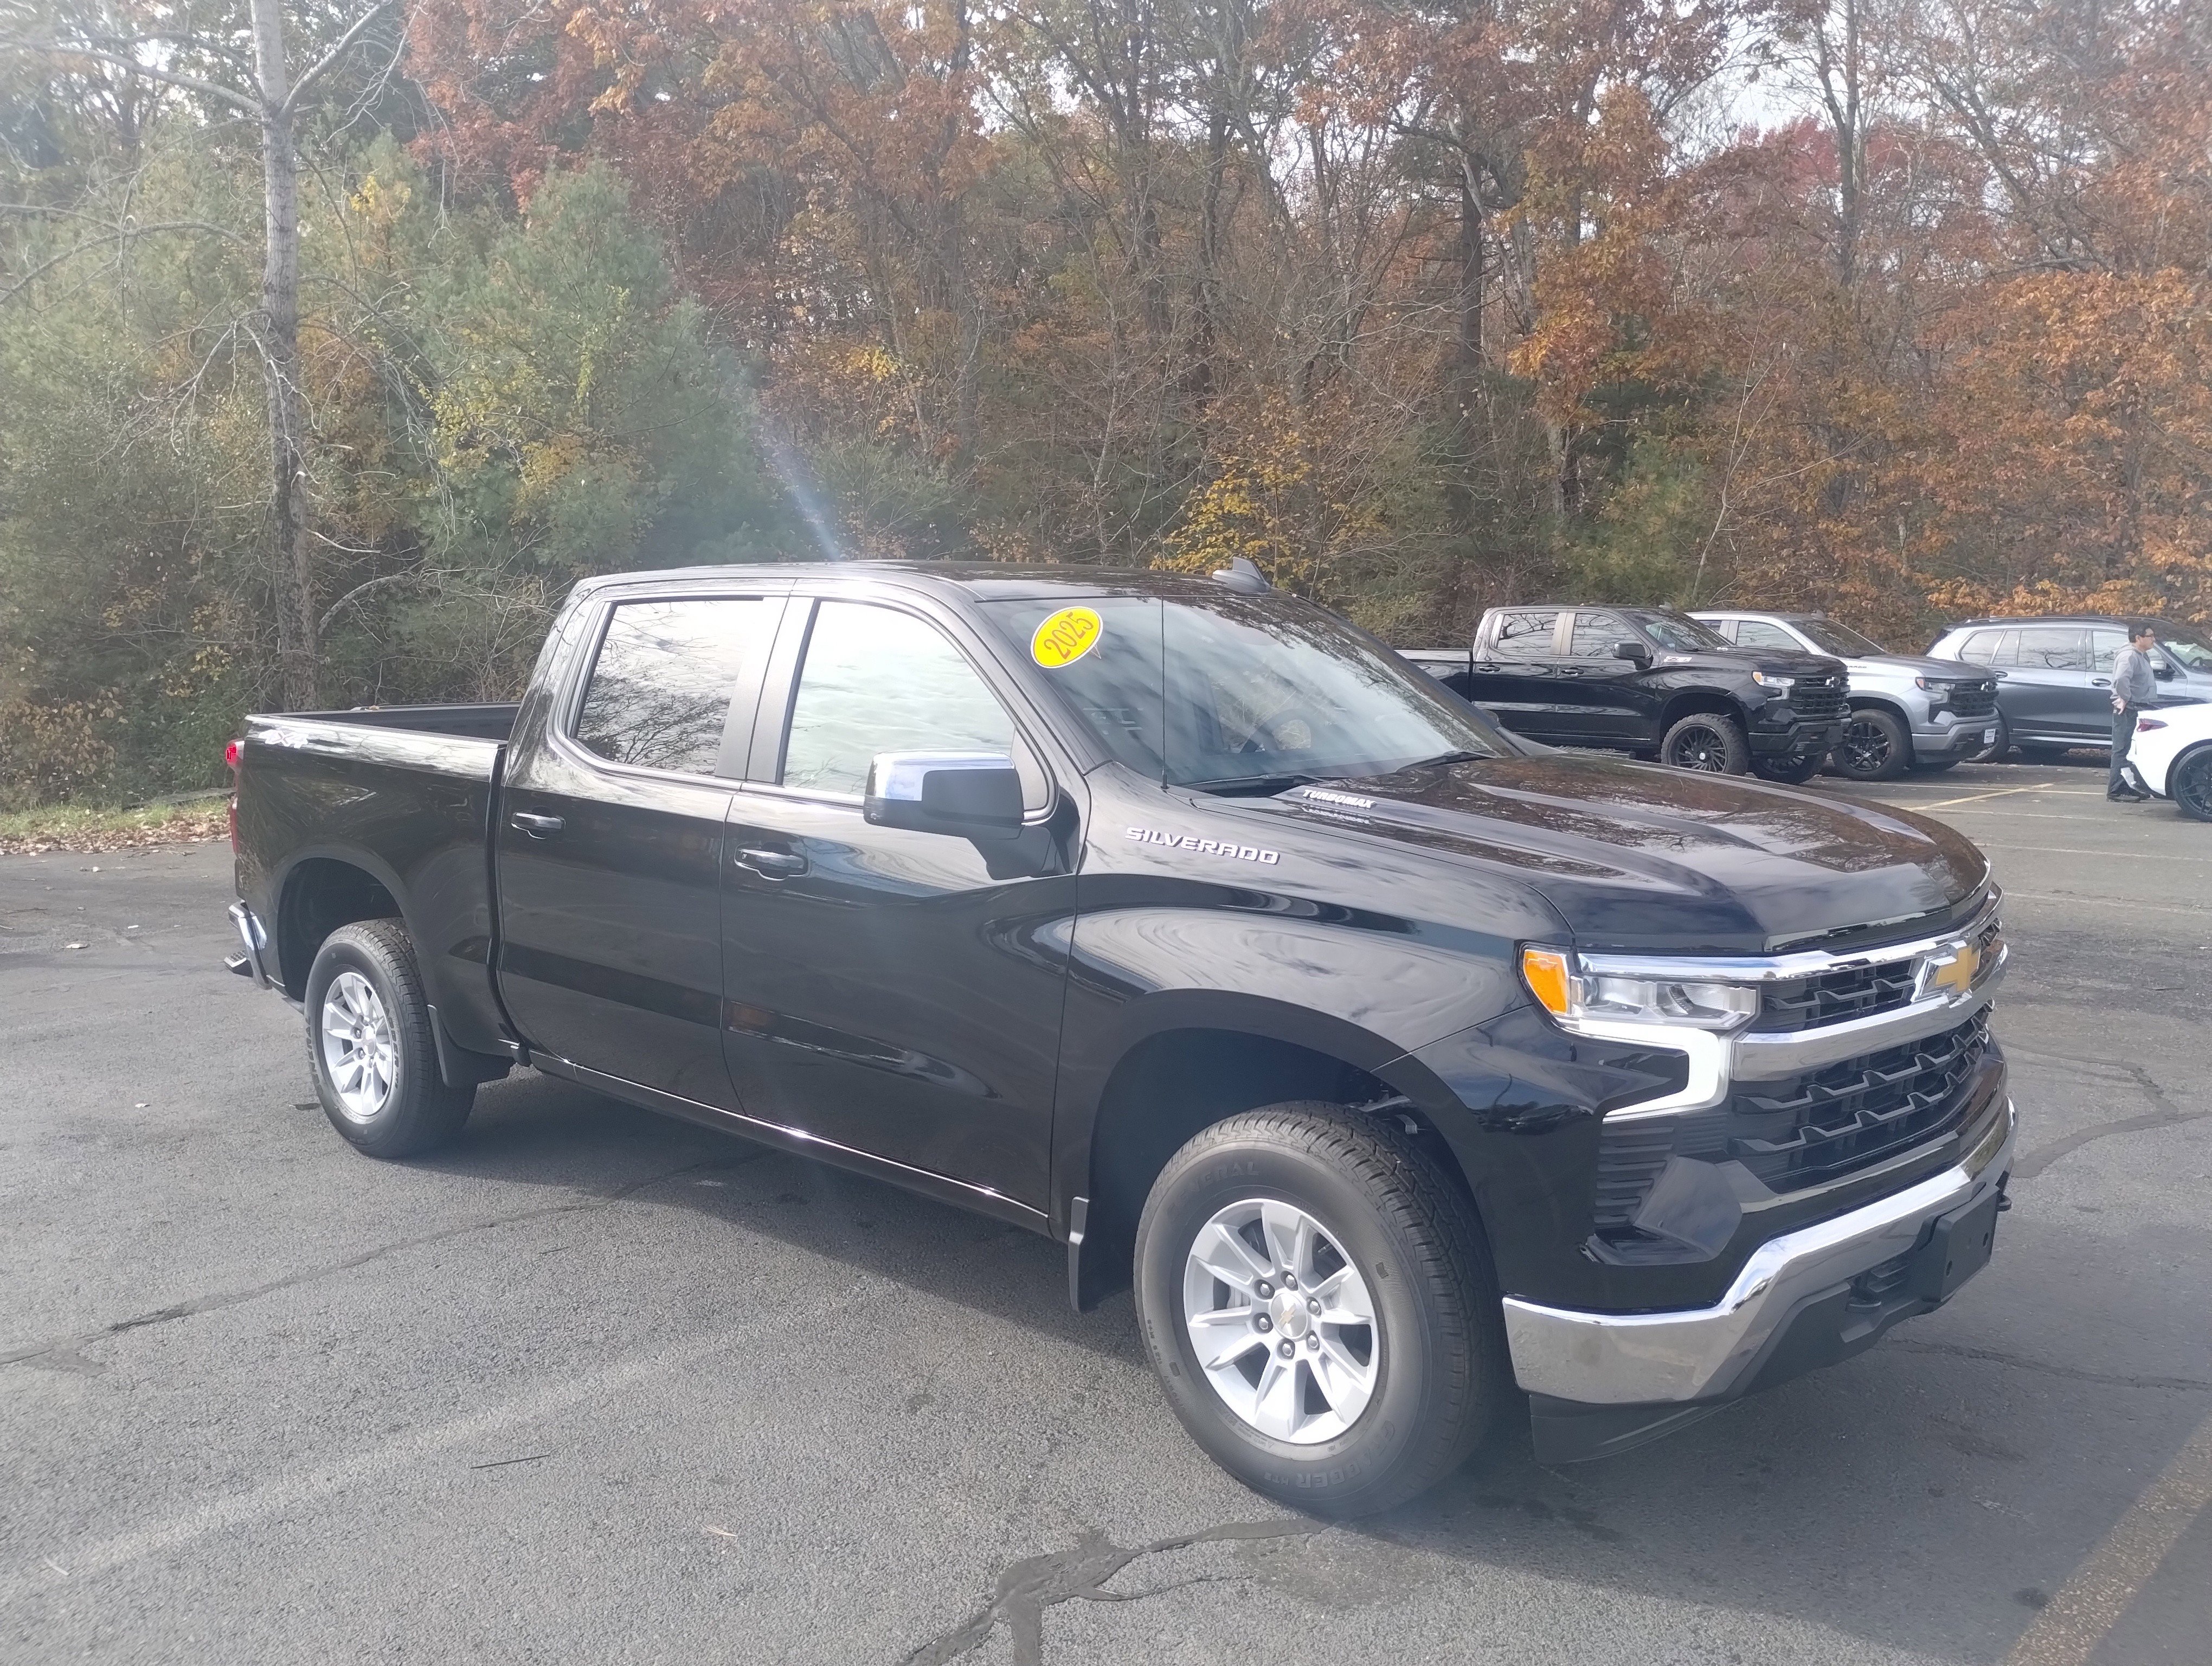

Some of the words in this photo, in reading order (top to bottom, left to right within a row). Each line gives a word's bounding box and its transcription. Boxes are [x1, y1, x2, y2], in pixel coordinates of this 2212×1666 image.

[1043, 612, 1094, 659] 2025
[1302, 789, 1377, 809] TURBOMAX
[1125, 826, 1280, 865] SILVERADO
